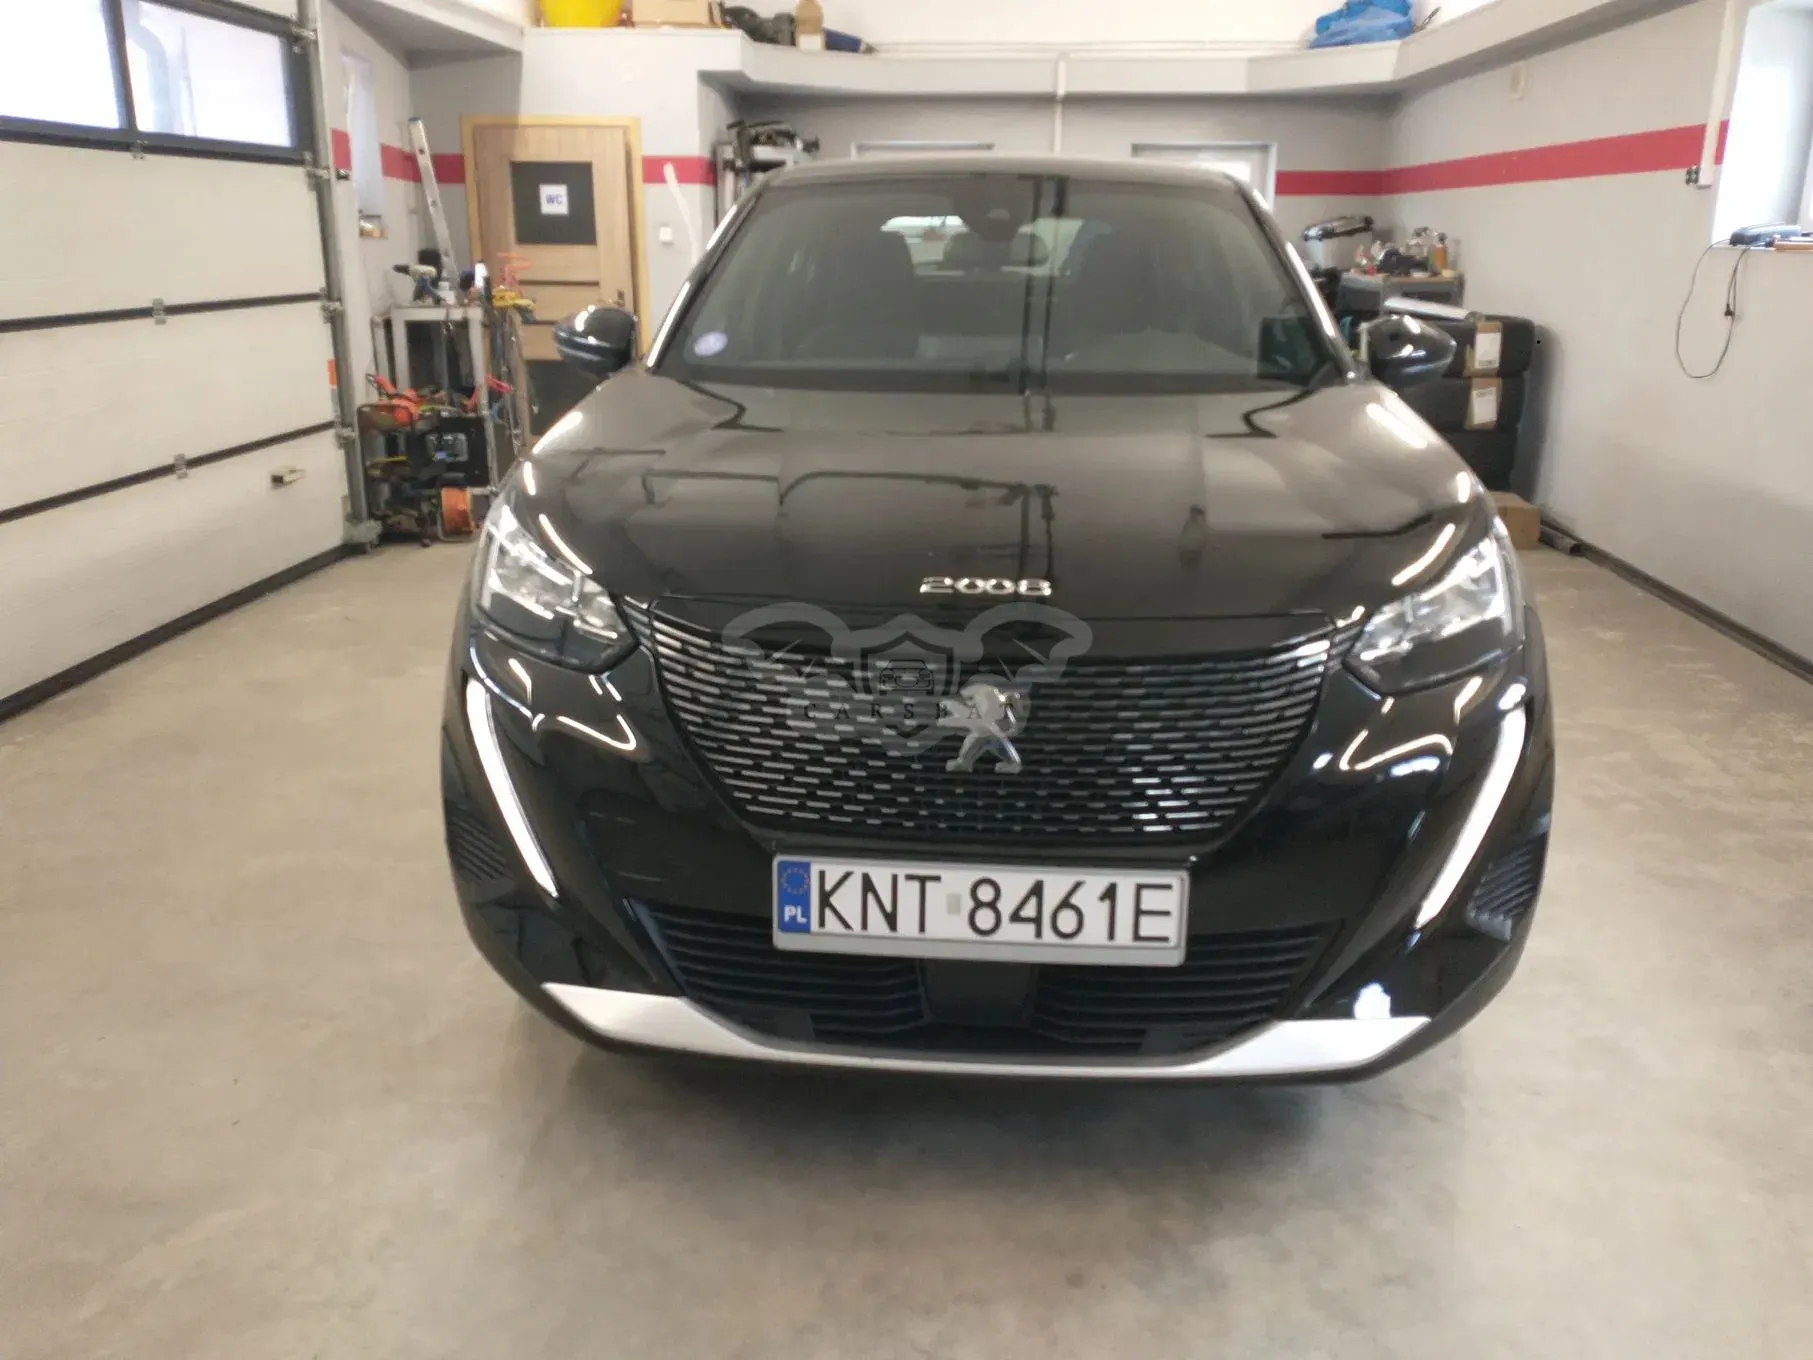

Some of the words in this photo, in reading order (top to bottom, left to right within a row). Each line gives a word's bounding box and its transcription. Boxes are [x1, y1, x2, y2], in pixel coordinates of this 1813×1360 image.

[545, 193, 563, 205] WC
[919, 576, 1052, 596] 2008
[783, 905, 807, 924] PL
[817, 869, 942, 933] KNT
[968, 877, 1174, 943] 8461E
